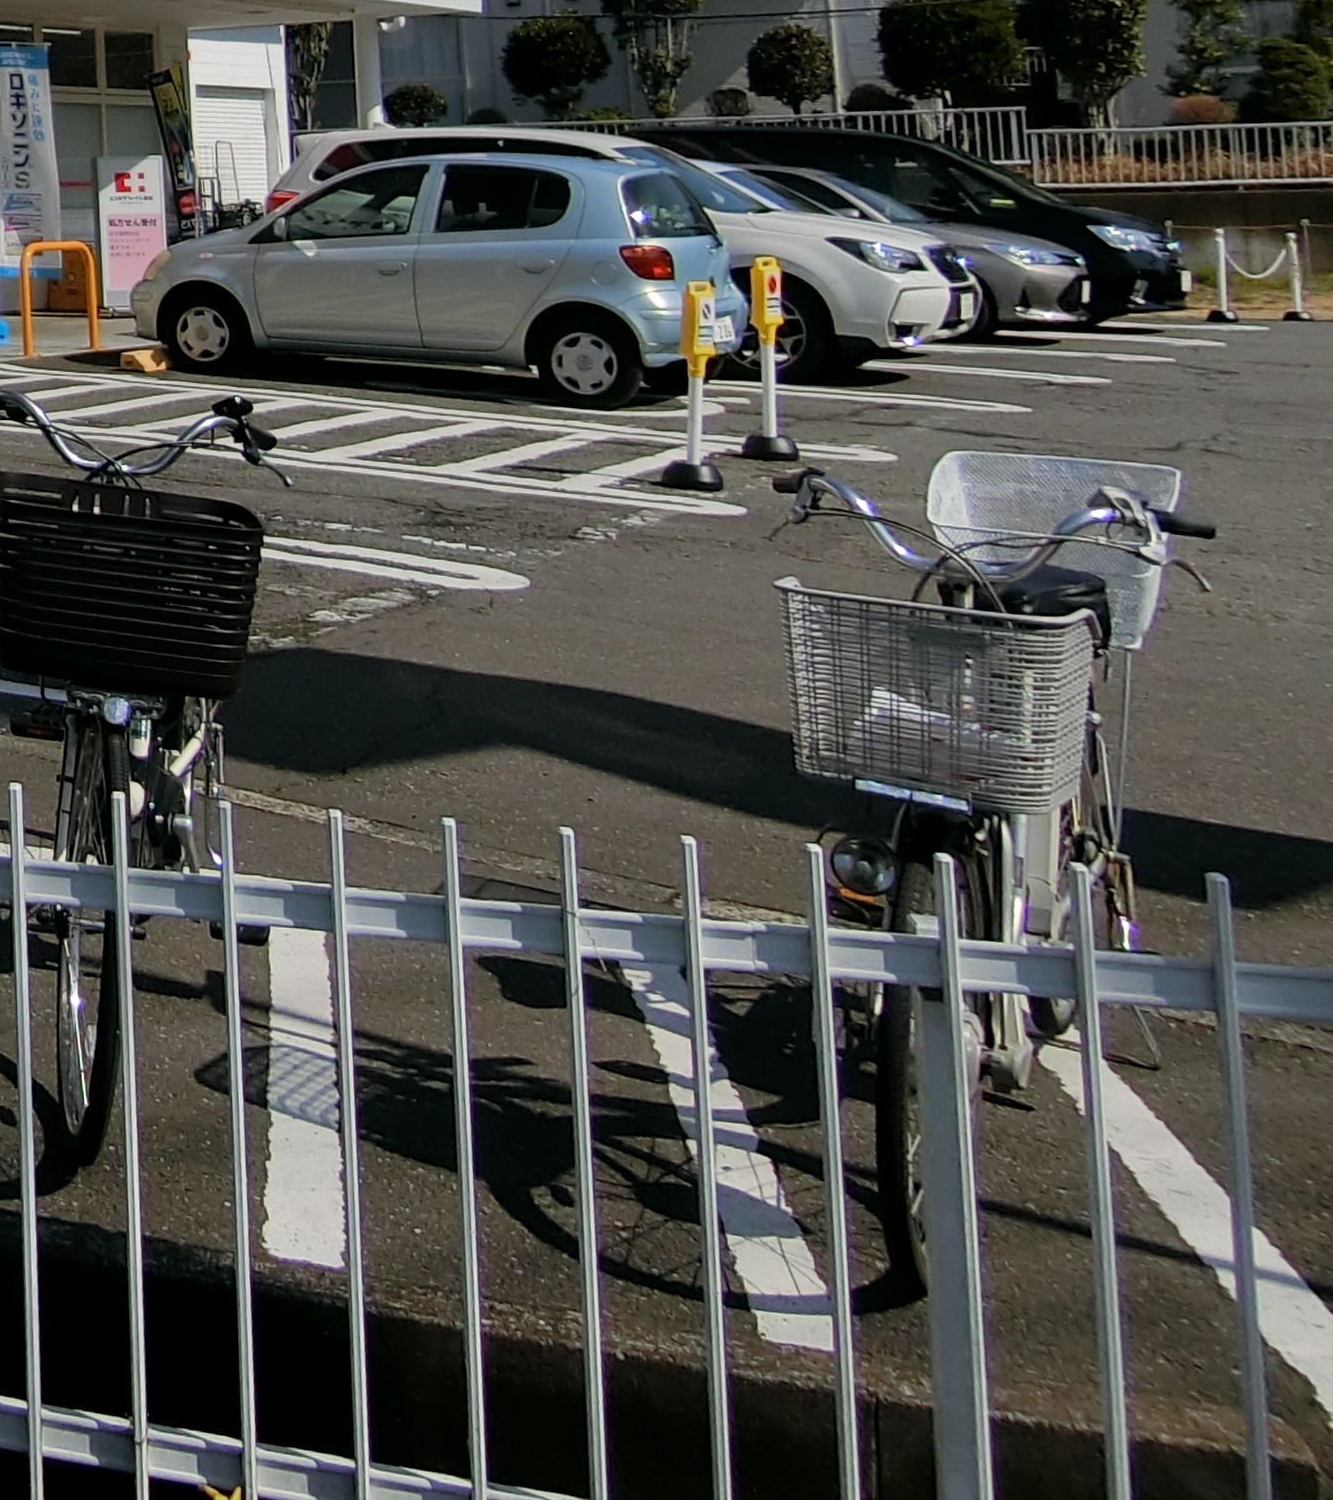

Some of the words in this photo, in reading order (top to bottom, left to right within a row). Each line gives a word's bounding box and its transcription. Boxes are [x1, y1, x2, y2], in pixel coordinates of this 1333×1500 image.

[9, 73, 30, 190] ロキソニンS
[108, 218, 157, 228] 処方せん受付
